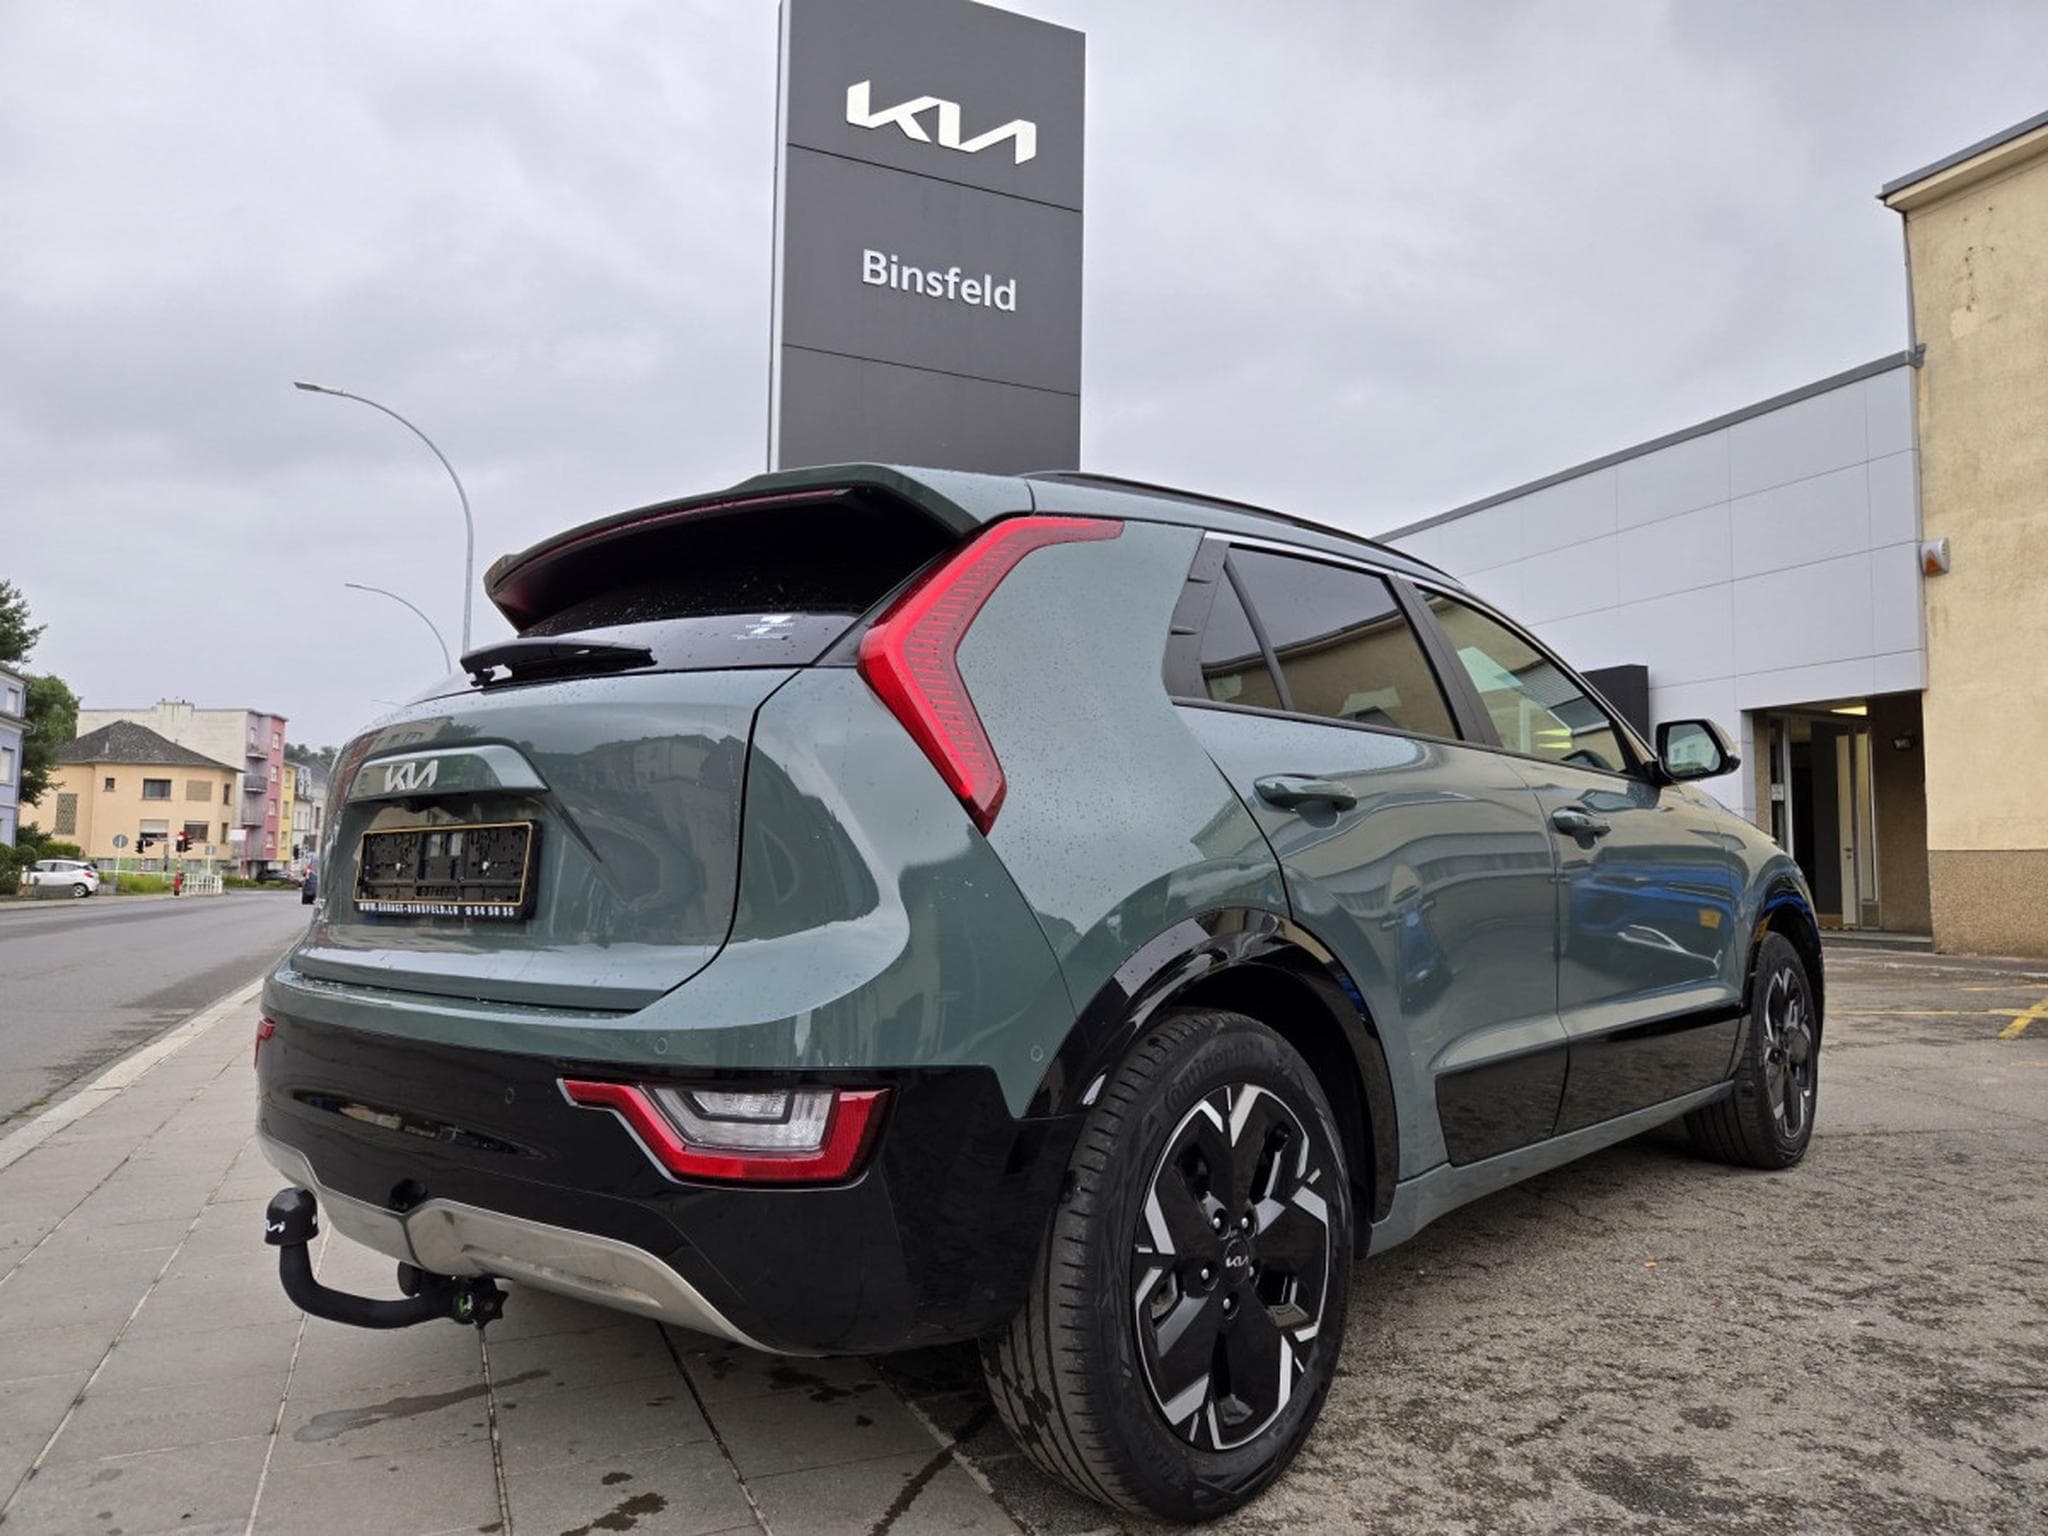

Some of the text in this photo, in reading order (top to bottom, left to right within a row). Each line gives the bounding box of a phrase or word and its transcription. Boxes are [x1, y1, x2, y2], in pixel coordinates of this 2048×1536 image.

[847, 79, 1037, 165] KIA
[862, 249, 1017, 311] Binsfeld
[384, 759, 438, 792] KIA
[1225, 1255, 1249, 1267] KIA
